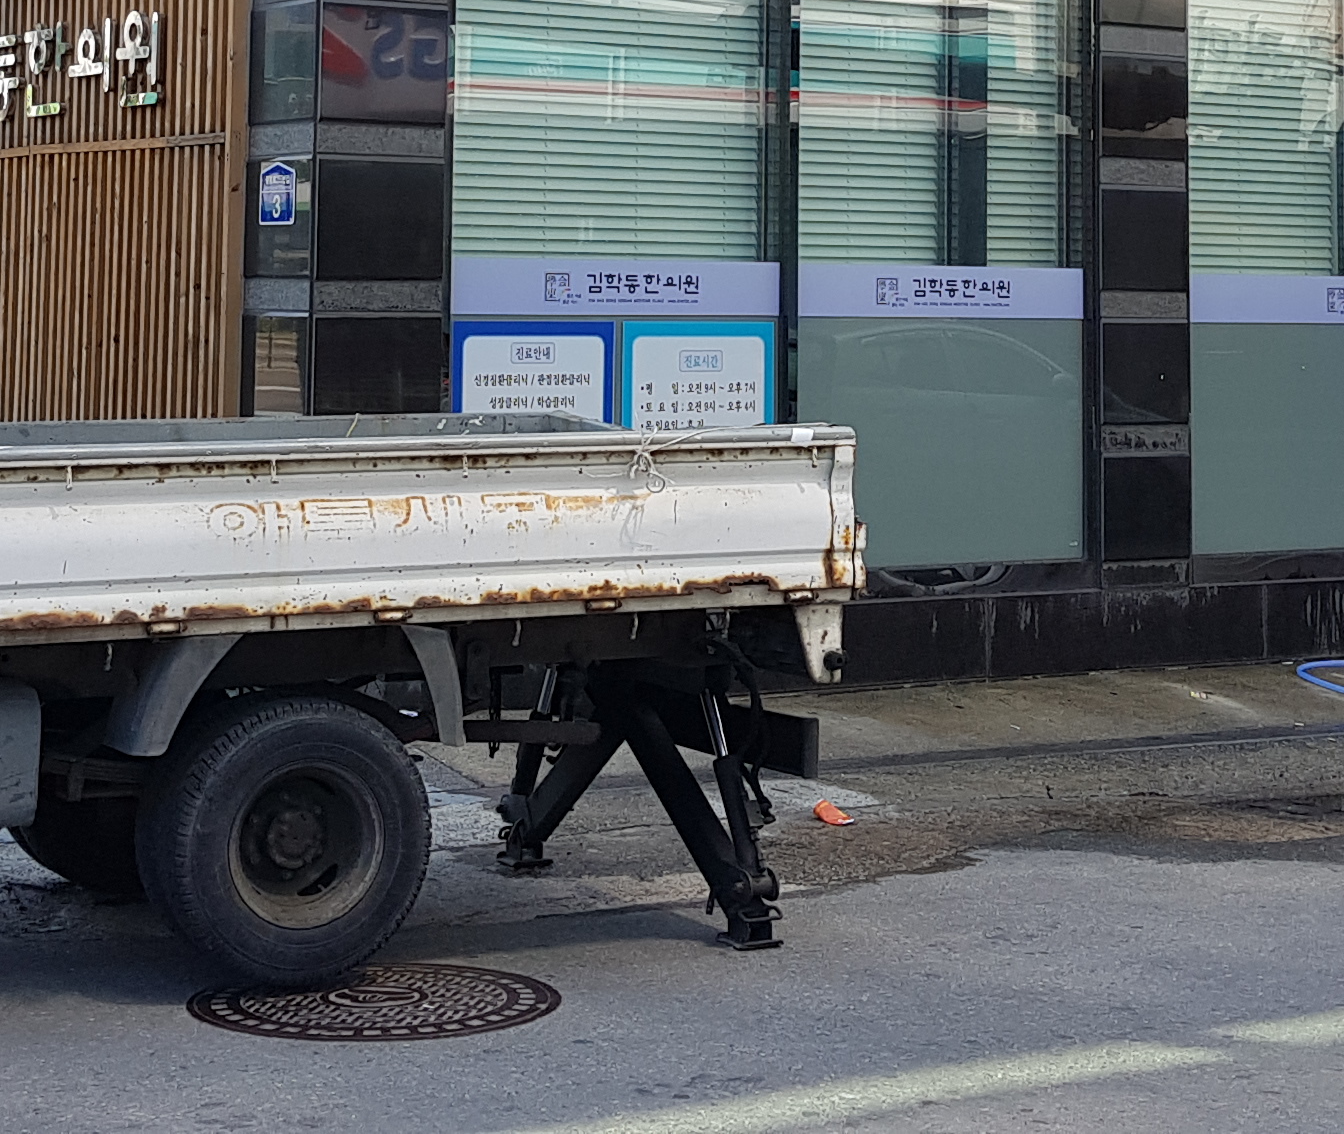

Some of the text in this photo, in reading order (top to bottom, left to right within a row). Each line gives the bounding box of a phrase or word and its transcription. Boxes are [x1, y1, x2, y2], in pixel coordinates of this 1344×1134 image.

[272, 194, 281, 219] 3
[586, 272, 700, 294] 김학동한의원
[912, 277, 1011, 299] 김학동한의원
[515, 346, 551, 360] 진료안내
[683, 354, 719, 368] 진료시간
